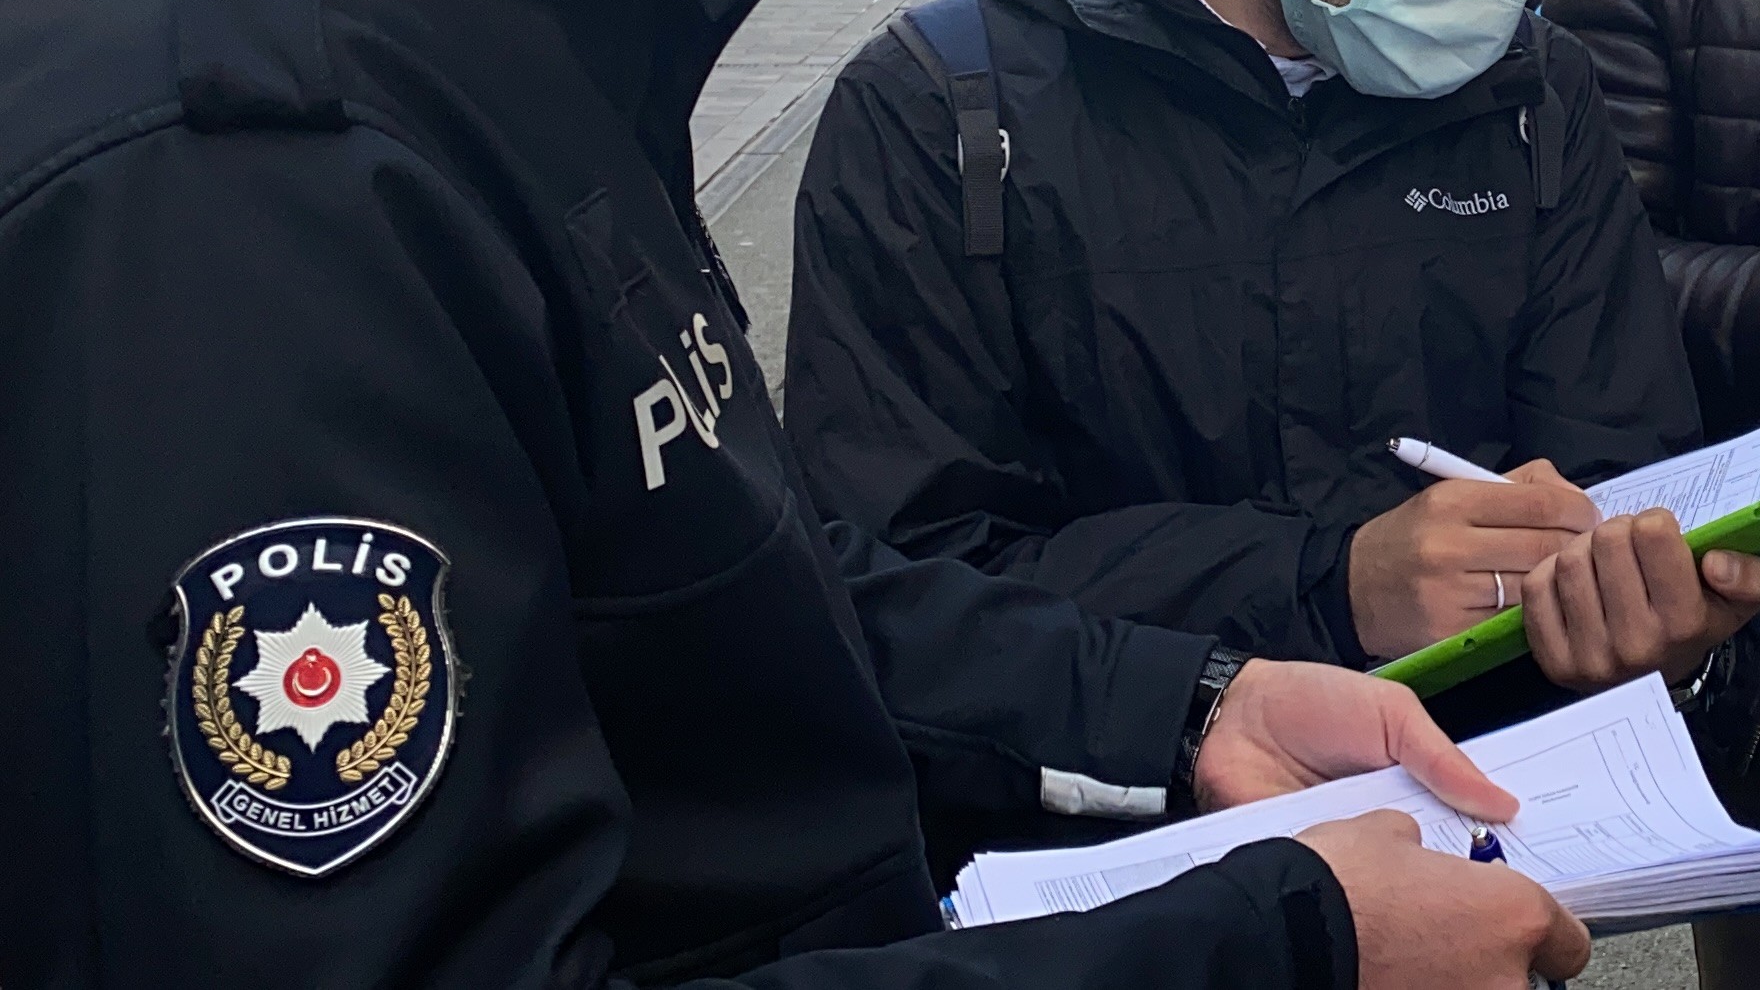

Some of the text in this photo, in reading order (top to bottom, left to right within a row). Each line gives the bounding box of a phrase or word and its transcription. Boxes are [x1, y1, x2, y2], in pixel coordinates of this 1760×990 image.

[1427, 188, 1510, 216] Columbia
[210, 532, 411, 602] POLİS
[233, 776, 399, 831] GENEL HİZMET
